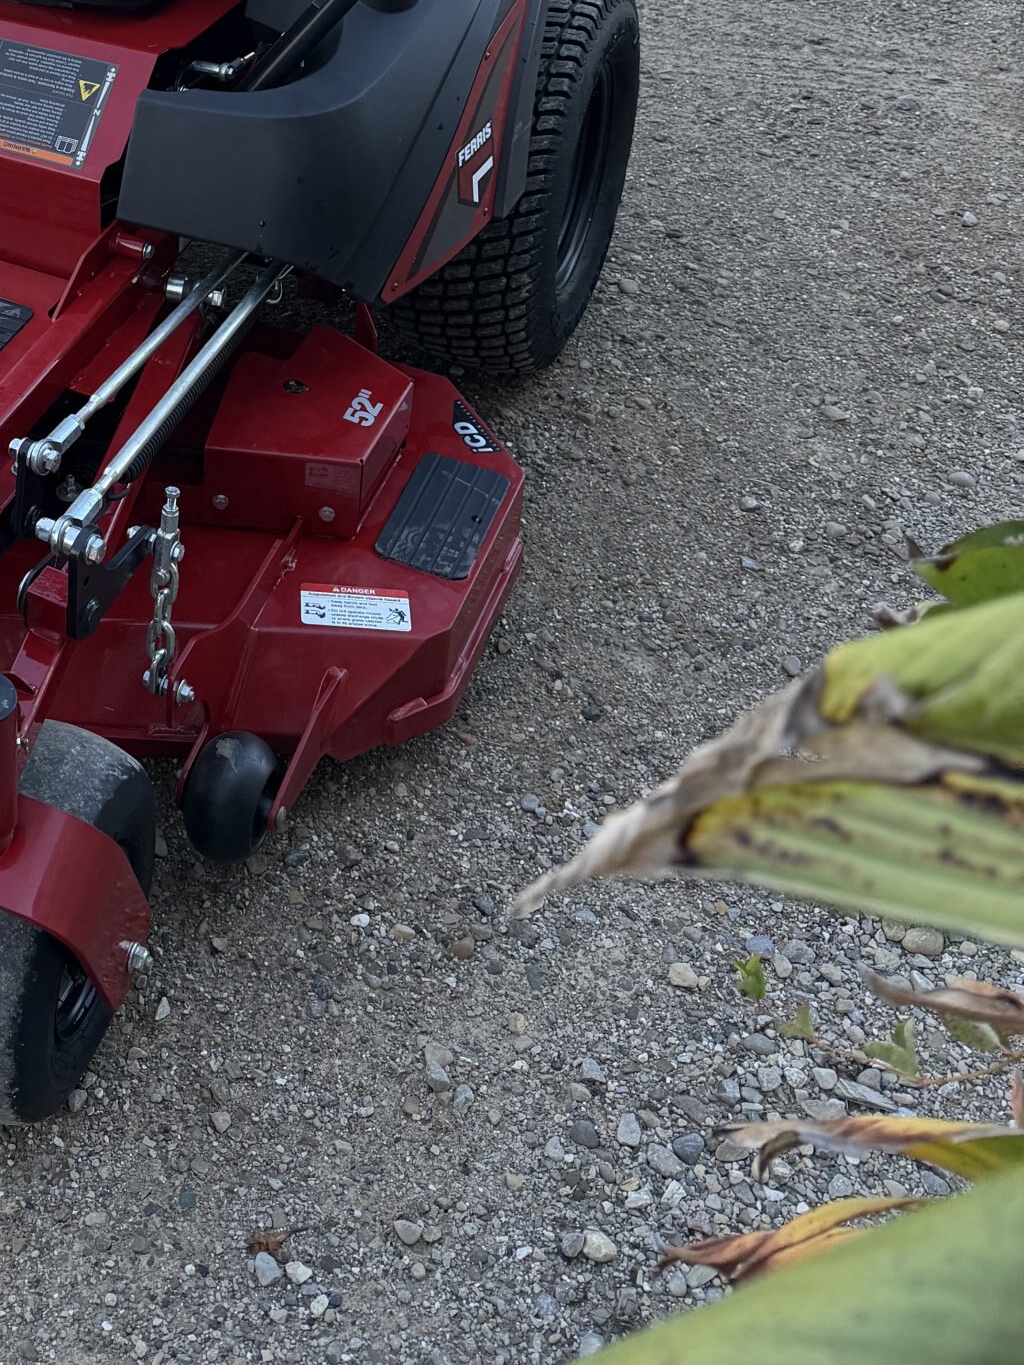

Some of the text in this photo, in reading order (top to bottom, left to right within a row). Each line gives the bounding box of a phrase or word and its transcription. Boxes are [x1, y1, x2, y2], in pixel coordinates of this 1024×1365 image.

[3, 141, 31, 153] WARNING
[458, 123, 492, 167] FERRIS
[342, 388, 385, 428] 52"
[340, 587, 376, 595] DANGER
